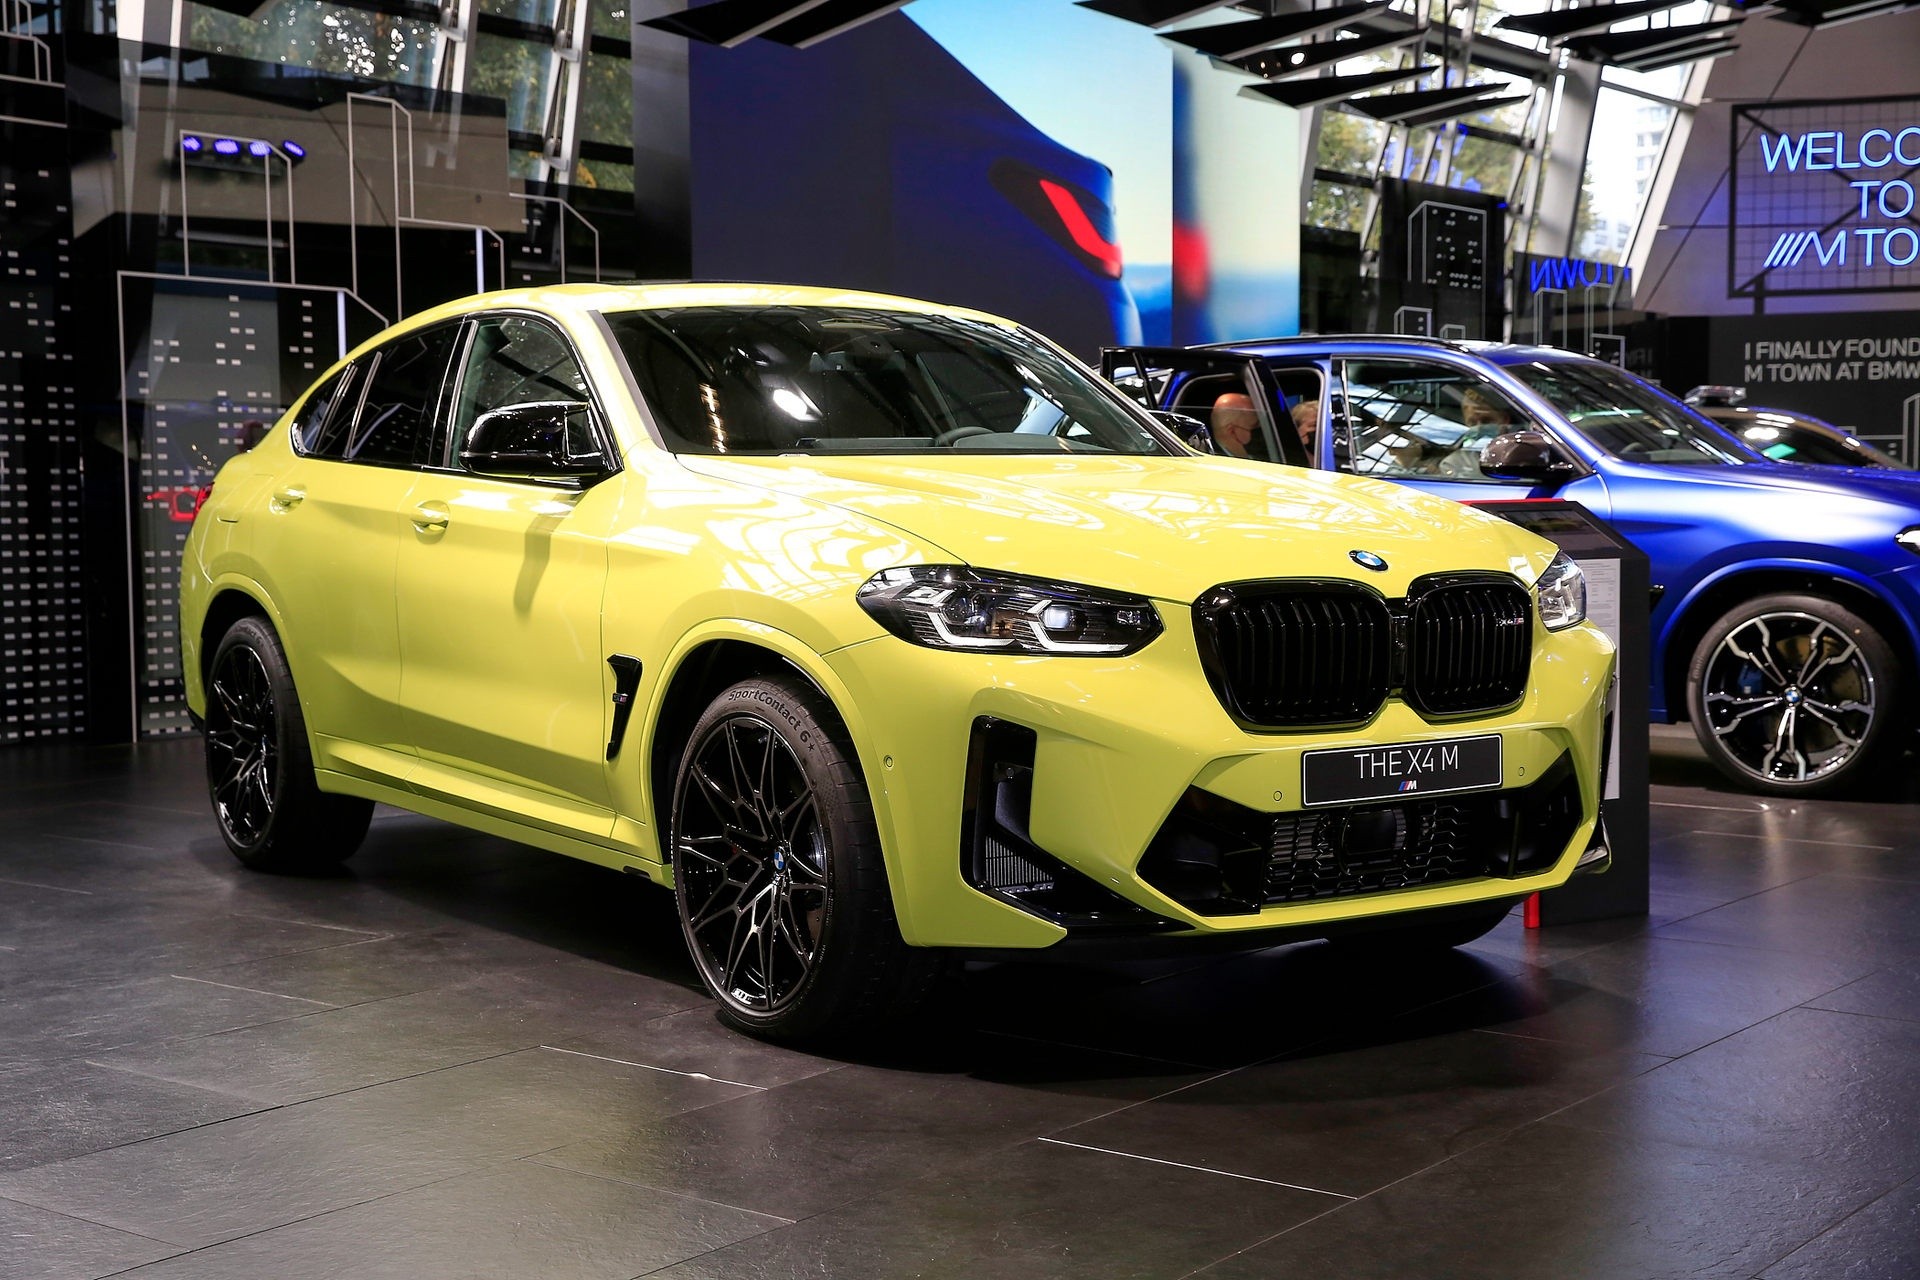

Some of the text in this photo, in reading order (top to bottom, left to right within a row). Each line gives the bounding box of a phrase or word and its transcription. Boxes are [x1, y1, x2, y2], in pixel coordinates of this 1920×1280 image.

[1850, 179, 1914, 219] TO
[1745, 337, 1920, 361] I FINALLY FOUND
[1744, 360, 1920, 383] M TOWN AT BMW
[728, 690, 810, 743] SportContact 6
[1354, 745, 1459, 779] THE X4 M
